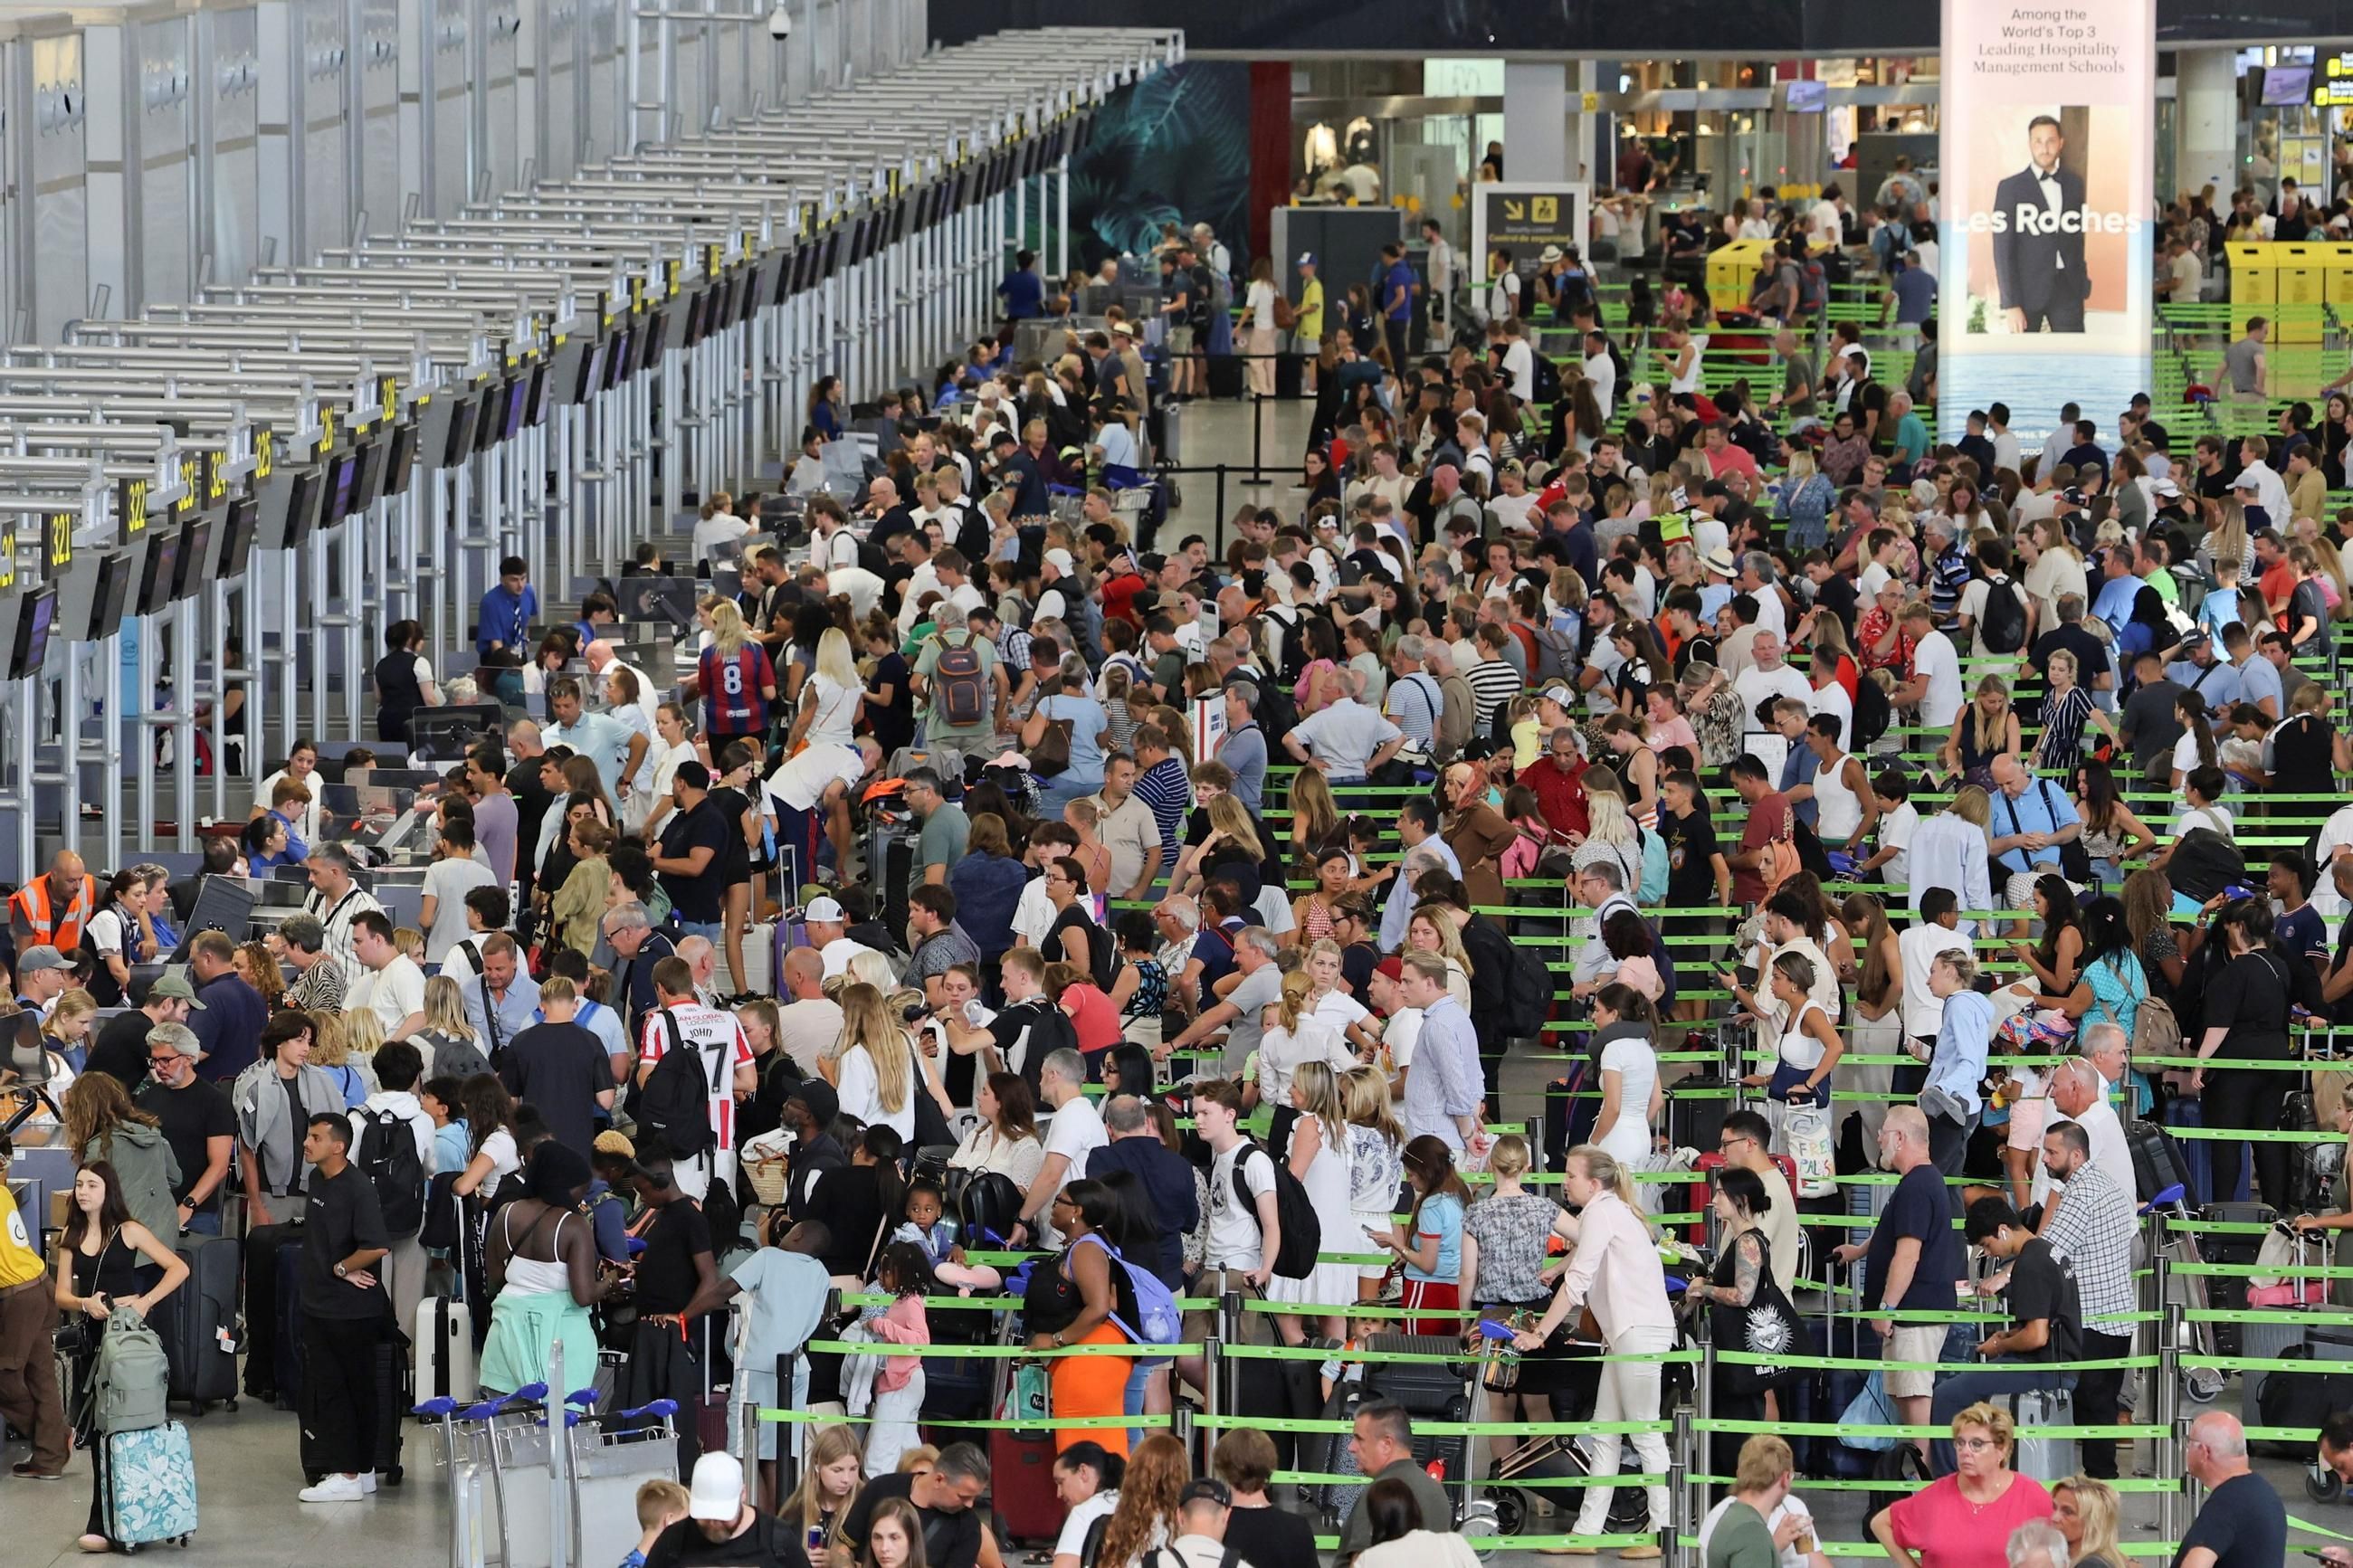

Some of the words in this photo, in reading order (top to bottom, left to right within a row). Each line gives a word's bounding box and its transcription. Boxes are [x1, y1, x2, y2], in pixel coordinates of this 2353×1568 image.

[2011, 9, 2062, 23] Among
[2064, 9, 2087, 21] the
[2001, 26, 2054, 38] World's
[2057, 26, 2083, 39] Top
[2087, 26, 2096, 38] 3
[1978, 43, 2035, 57] Leading
[2040, 43, 2120, 58] Hospitality
[1973, 61, 2064, 75] Management
[2069, 60, 2126, 73] Schools
[1951, 203, 2008, 233] Les
[2015, 203, 2142, 236] Roches
[255, 430, 272, 480] 325
[129, 480, 146, 533] 322
[52, 513, 71, 566] 321
[723, 665, 742, 694] 8
